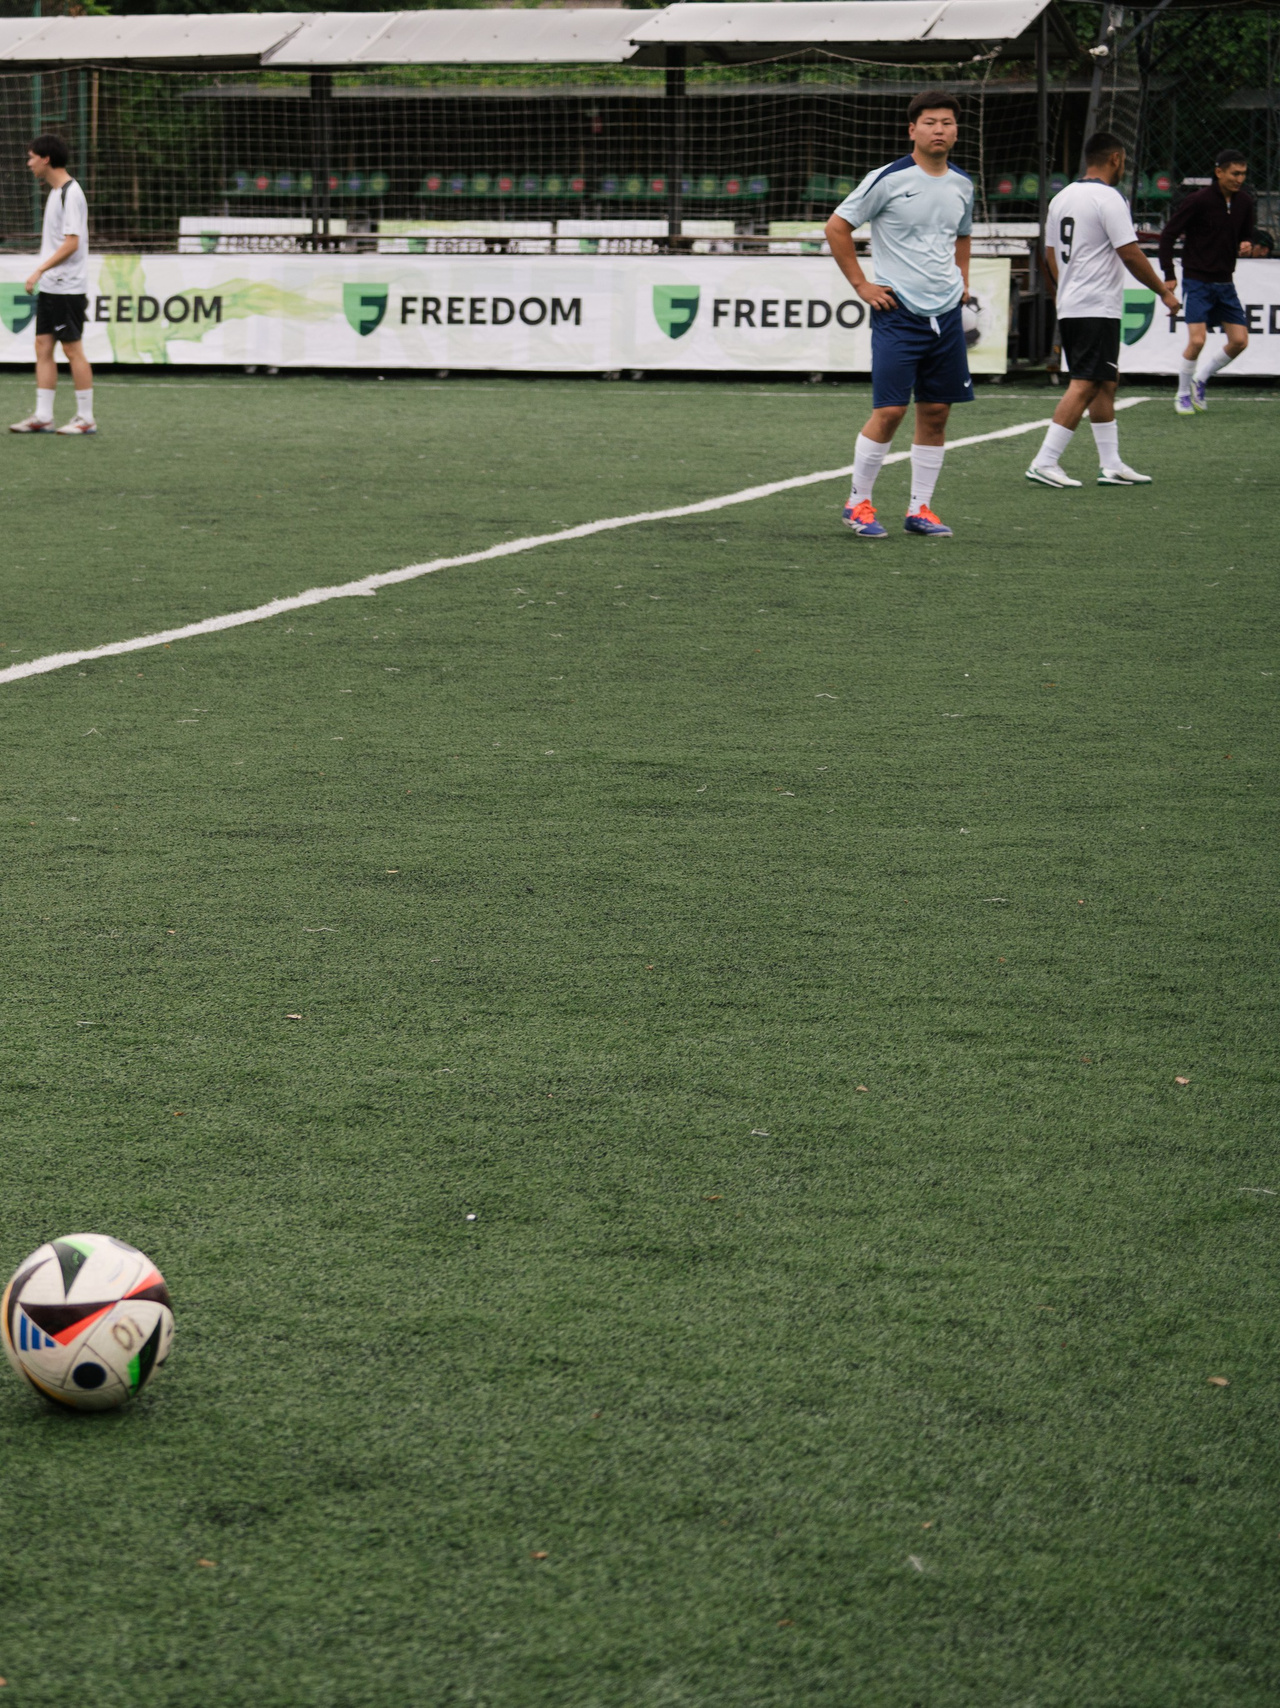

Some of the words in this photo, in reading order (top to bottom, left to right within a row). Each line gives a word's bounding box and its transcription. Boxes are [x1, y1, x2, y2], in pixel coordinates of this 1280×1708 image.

[1060, 217, 1075, 264] 9
[400, 296, 582, 326] FREEDOM
[712, 298, 873, 329] FREEDO
